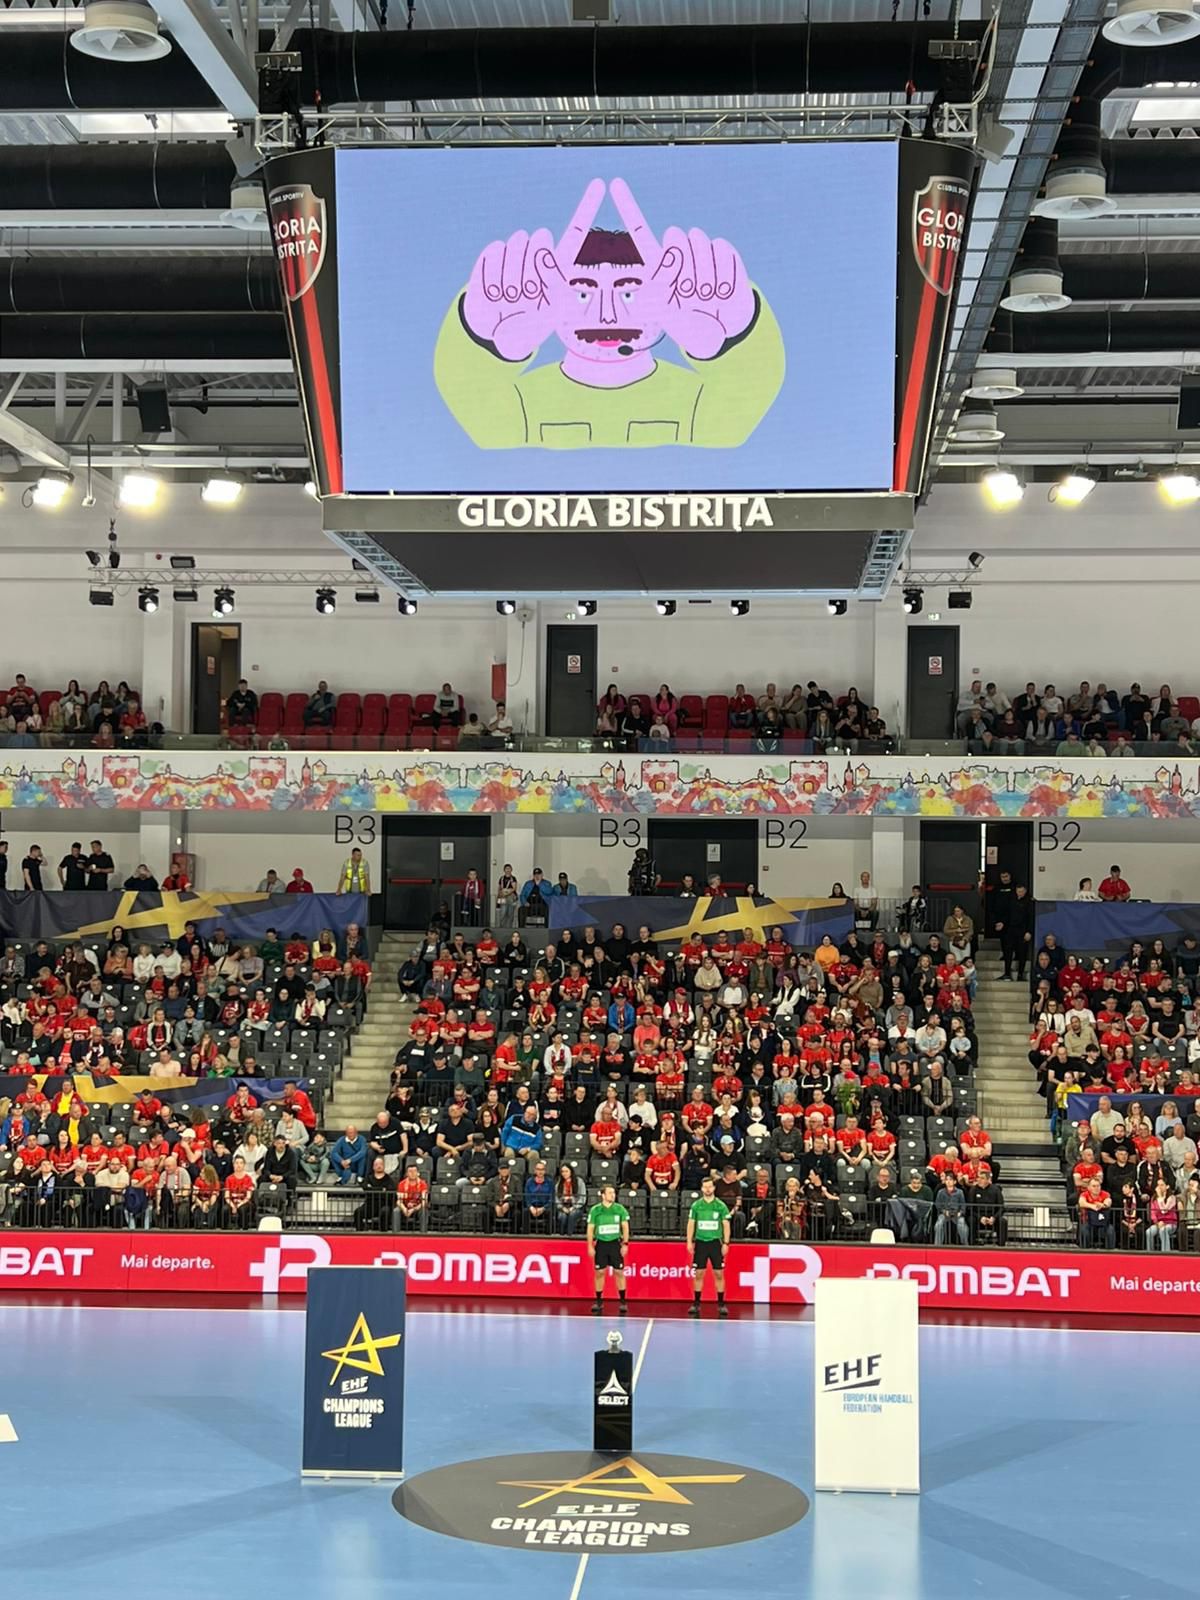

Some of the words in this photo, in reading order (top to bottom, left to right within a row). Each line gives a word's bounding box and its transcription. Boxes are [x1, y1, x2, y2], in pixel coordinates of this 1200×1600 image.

[918, 208, 965, 234] GLOR
[458, 496, 597, 528] GLORIA
[334, 815, 376, 845] B3
[600, 818, 641, 848] B3
[765, 819, 808, 849] B2
[1038, 821, 1083, 851] B2
[121, 1255, 149, 1269] Mai
[152, 1255, 215, 1271] departe.
[1110, 1276, 1139, 1291] Mai
[824, 1353, 882, 1386] EHF
[341, 1376, 369, 1393] EHF
[323, 1398, 384, 1414] CHAMPIONS
[598, 1396, 629, 1406] SELECT
[334, 1413, 373, 1428] LEAGUE
[555, 1503, 641, 1515] EHF
[490, 1517, 691, 1536] CHAMPIONS
[524, 1531, 649, 1547] LEAGUE
